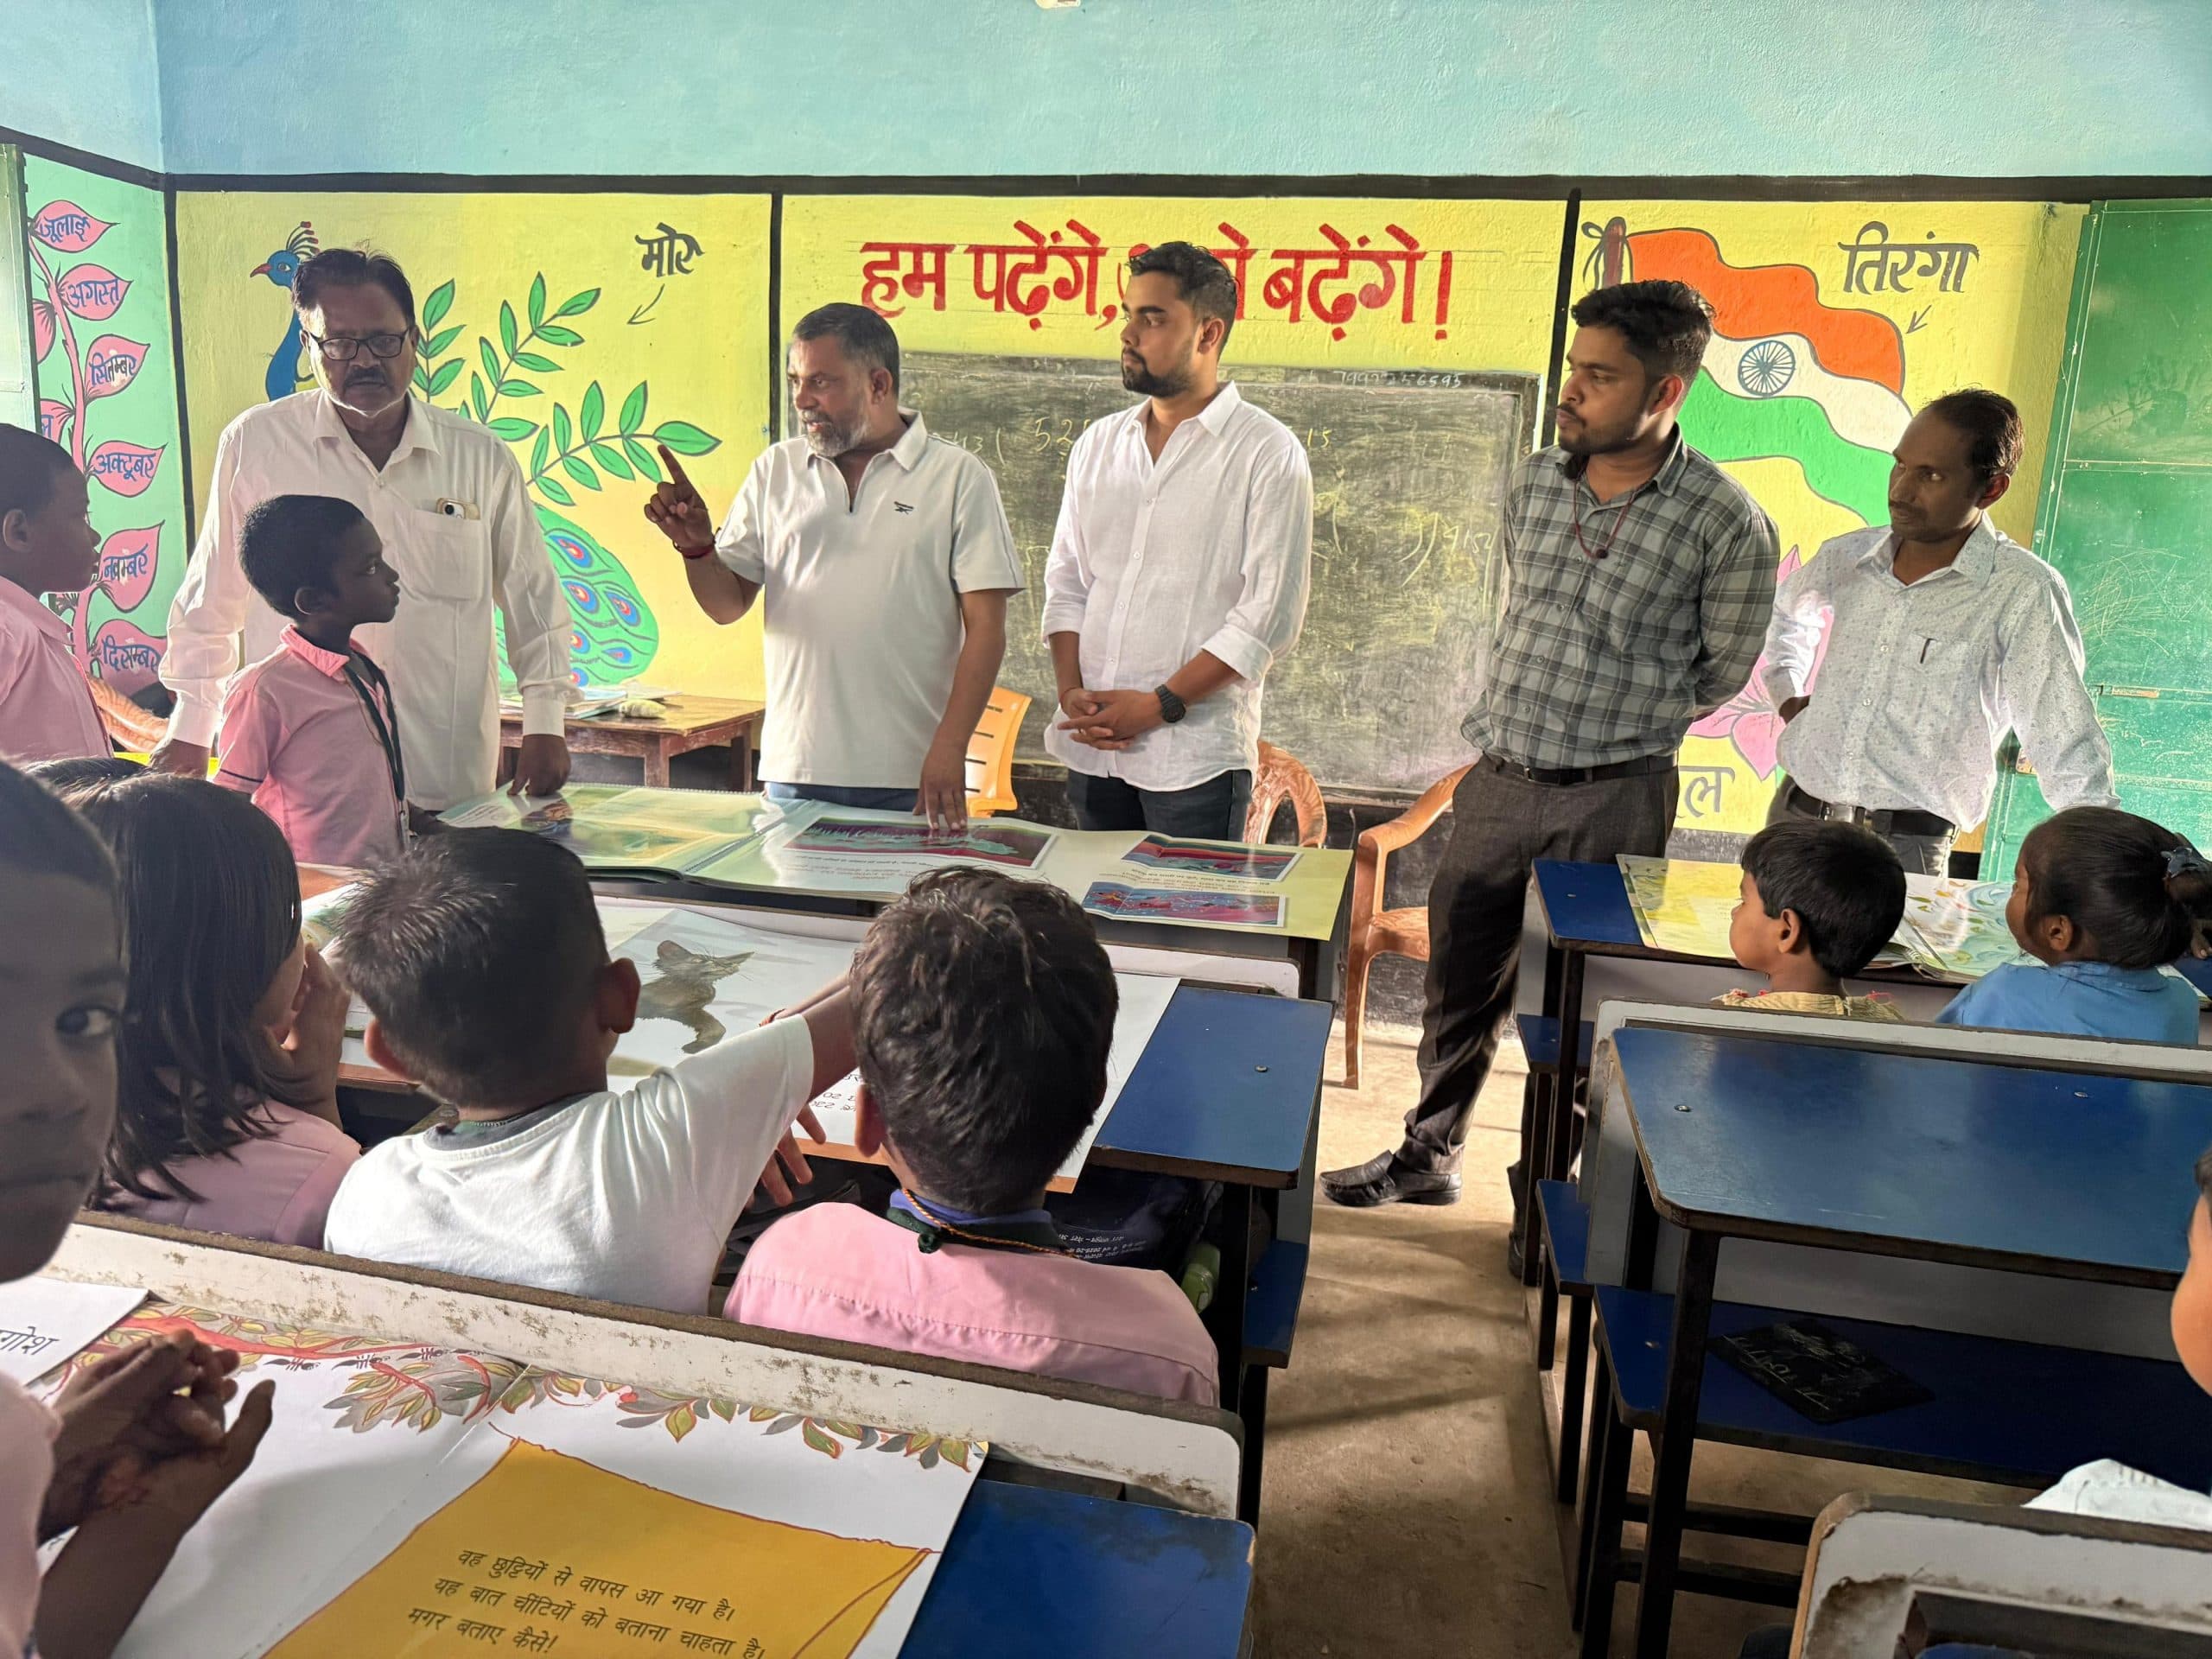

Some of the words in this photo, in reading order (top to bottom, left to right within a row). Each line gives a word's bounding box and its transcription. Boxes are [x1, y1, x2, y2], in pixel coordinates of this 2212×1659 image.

[634, 221, 706, 278] मोर
[1837, 220, 1980, 296] तिरंगा
[67, 277, 119, 308] अगस्त
[859, 242, 957, 319] हम
[89, 352, 137, 386] सितम्बर
[93, 452, 156, 482] अक्टूबर
[103, 542, 149, 582] नवम्बर
[0, 1325, 60, 1356] गोश
[458, 1549, 488, 1567] वह
[488, 1555, 549, 1581] छुट्टियों
[554, 1566, 574, 1587] से
[580, 1575, 629, 1599] वापस
[635, 1588, 664, 1607] आ
[671, 1595, 709, 1616] गया
[713, 1598, 736, 1622] है।
[407, 1607, 453, 1631] मगर
[456, 1618, 507, 1645] बताए
[512, 1625, 560, 1654] कैसे!
[434, 1577, 464, 1598] यह
[469, 1586, 507, 1607] बात
[513, 1592, 576, 1622] चींटियों
[581, 1606, 609, 1630] को
[614, 1617, 671, 1643] बताना
[679, 1630, 737, 1656] चाहता
